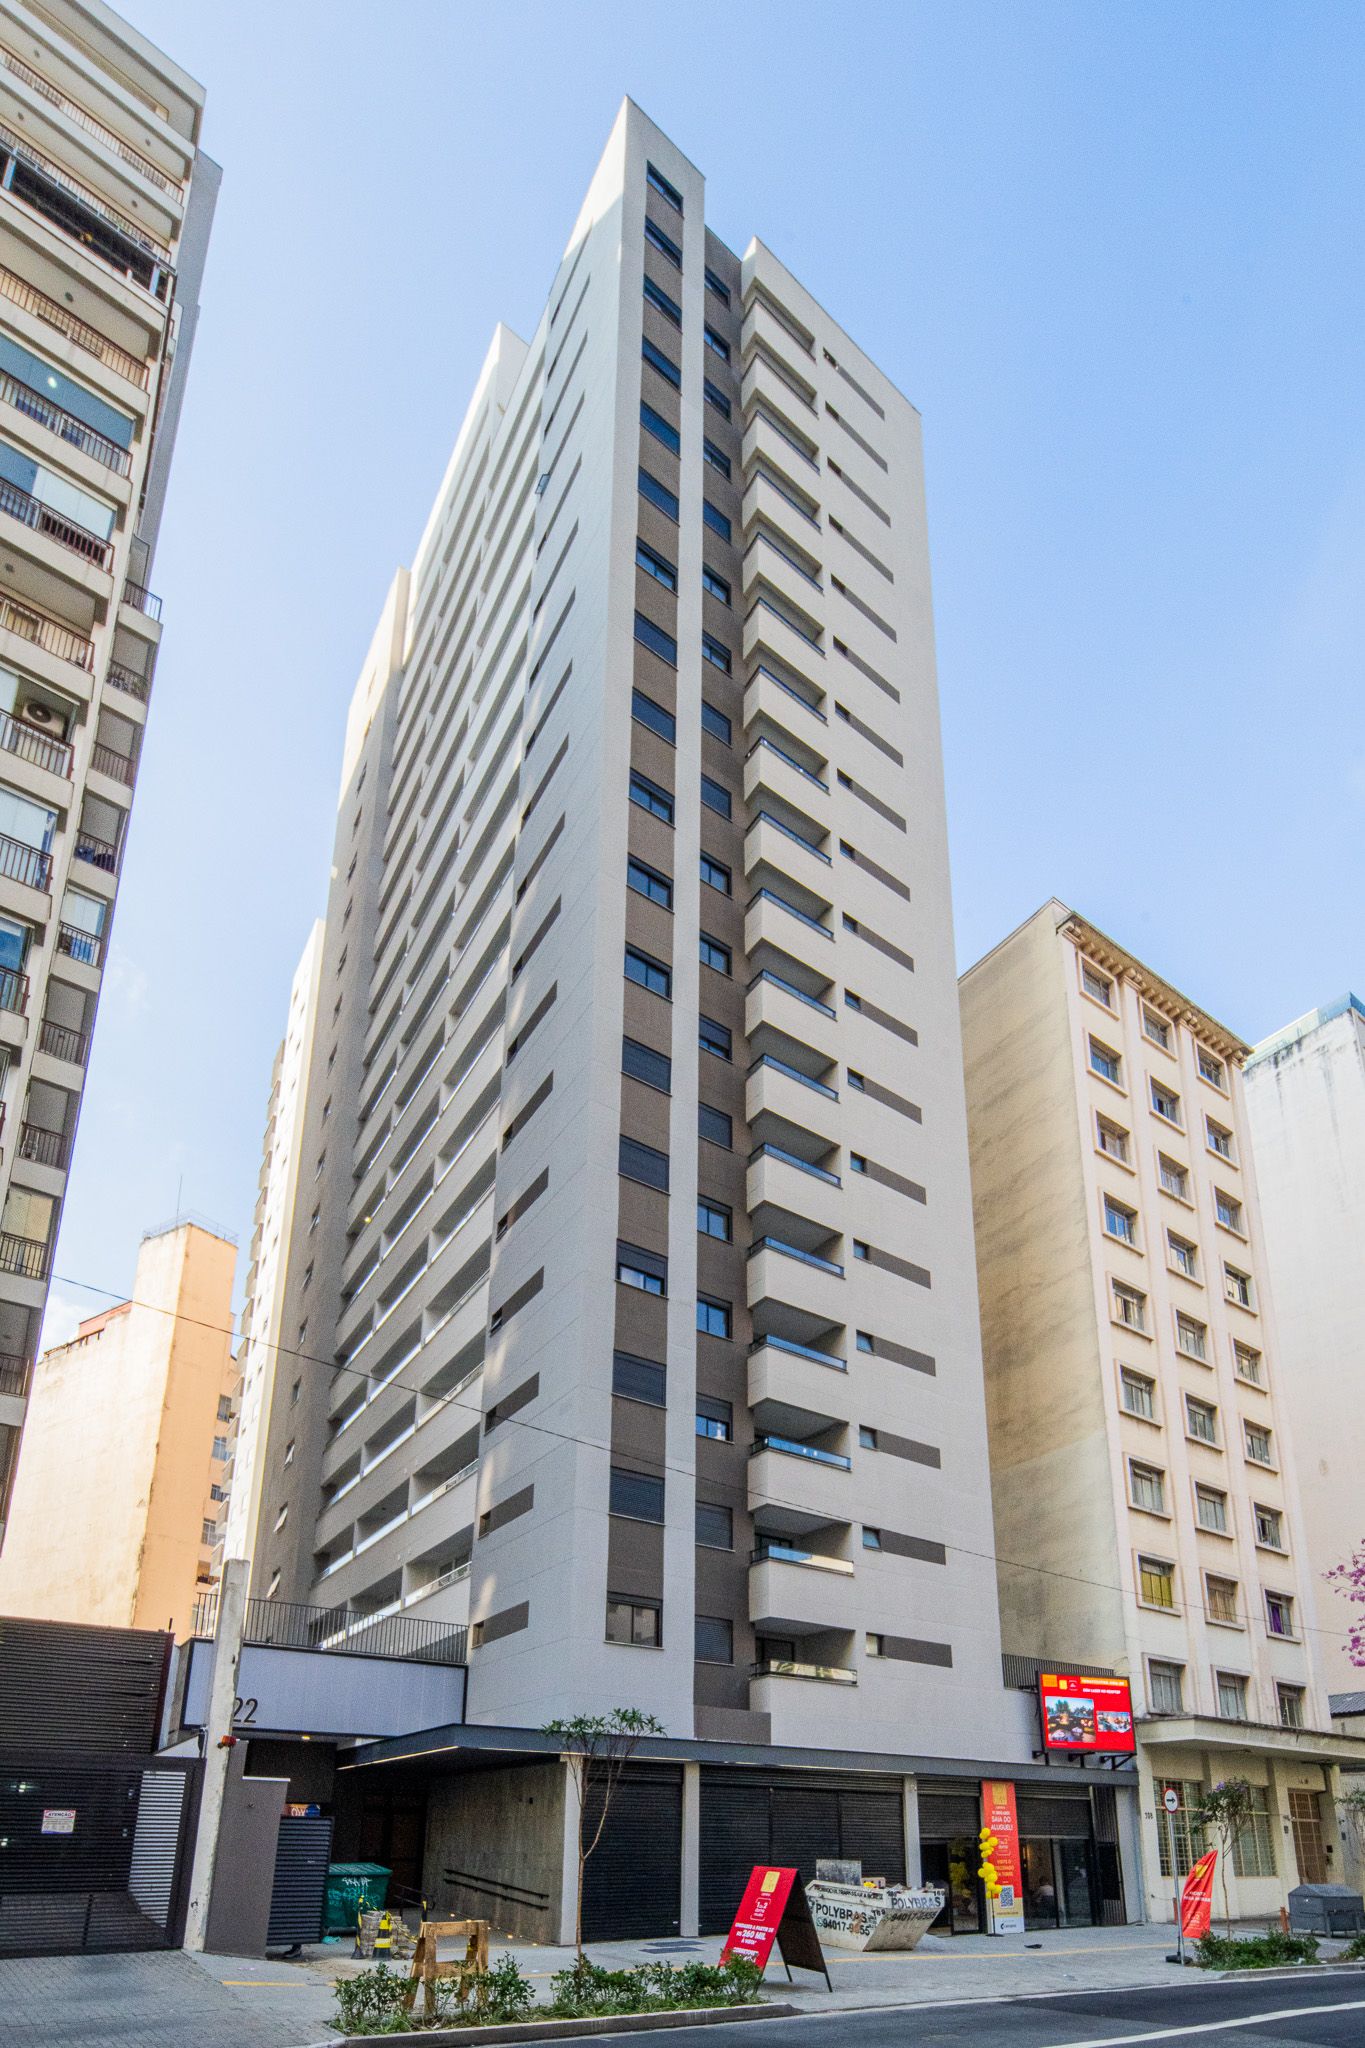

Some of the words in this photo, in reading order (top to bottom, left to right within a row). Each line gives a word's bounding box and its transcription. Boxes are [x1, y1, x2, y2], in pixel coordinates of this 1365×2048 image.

[892, 1896, 942, 1909] POLYBRAS
[816, 1903, 867, 1923] POLYBRAS
[742, 1929, 755, 1938] 260
[755, 1931, 766, 1940] MIL
